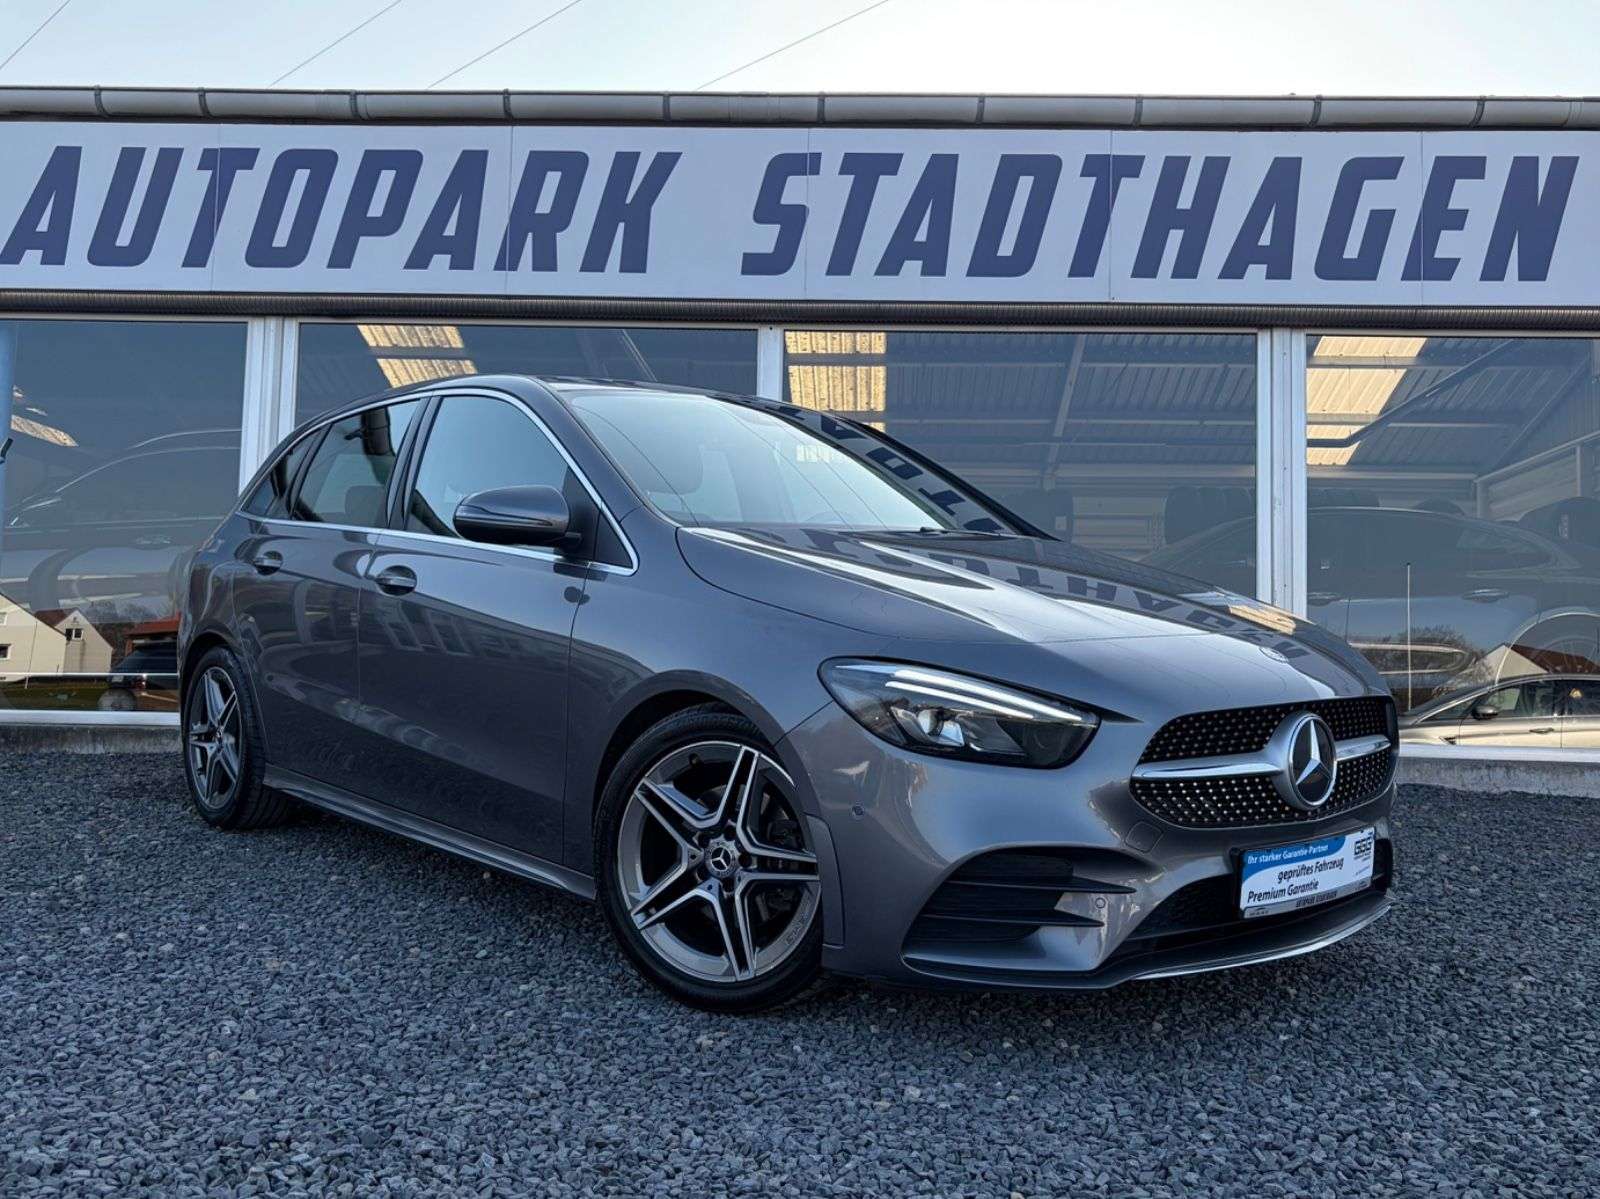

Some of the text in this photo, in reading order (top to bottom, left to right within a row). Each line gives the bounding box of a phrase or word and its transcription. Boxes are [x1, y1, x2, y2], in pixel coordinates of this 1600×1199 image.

[0, 146, 1579, 281] AUTOPARK STADTHAGEN
[1248, 855, 1257, 864] Ihr
[1260, 853, 1281, 863] starker
[1283, 849, 1308, 859] Garantie
[1278, 864, 1313, 884] geprüftes
[1314, 857, 1344, 873] Fahrzeug
[1247, 887, 1286, 903] Premium
[1287, 879, 1319, 896] Garantie
